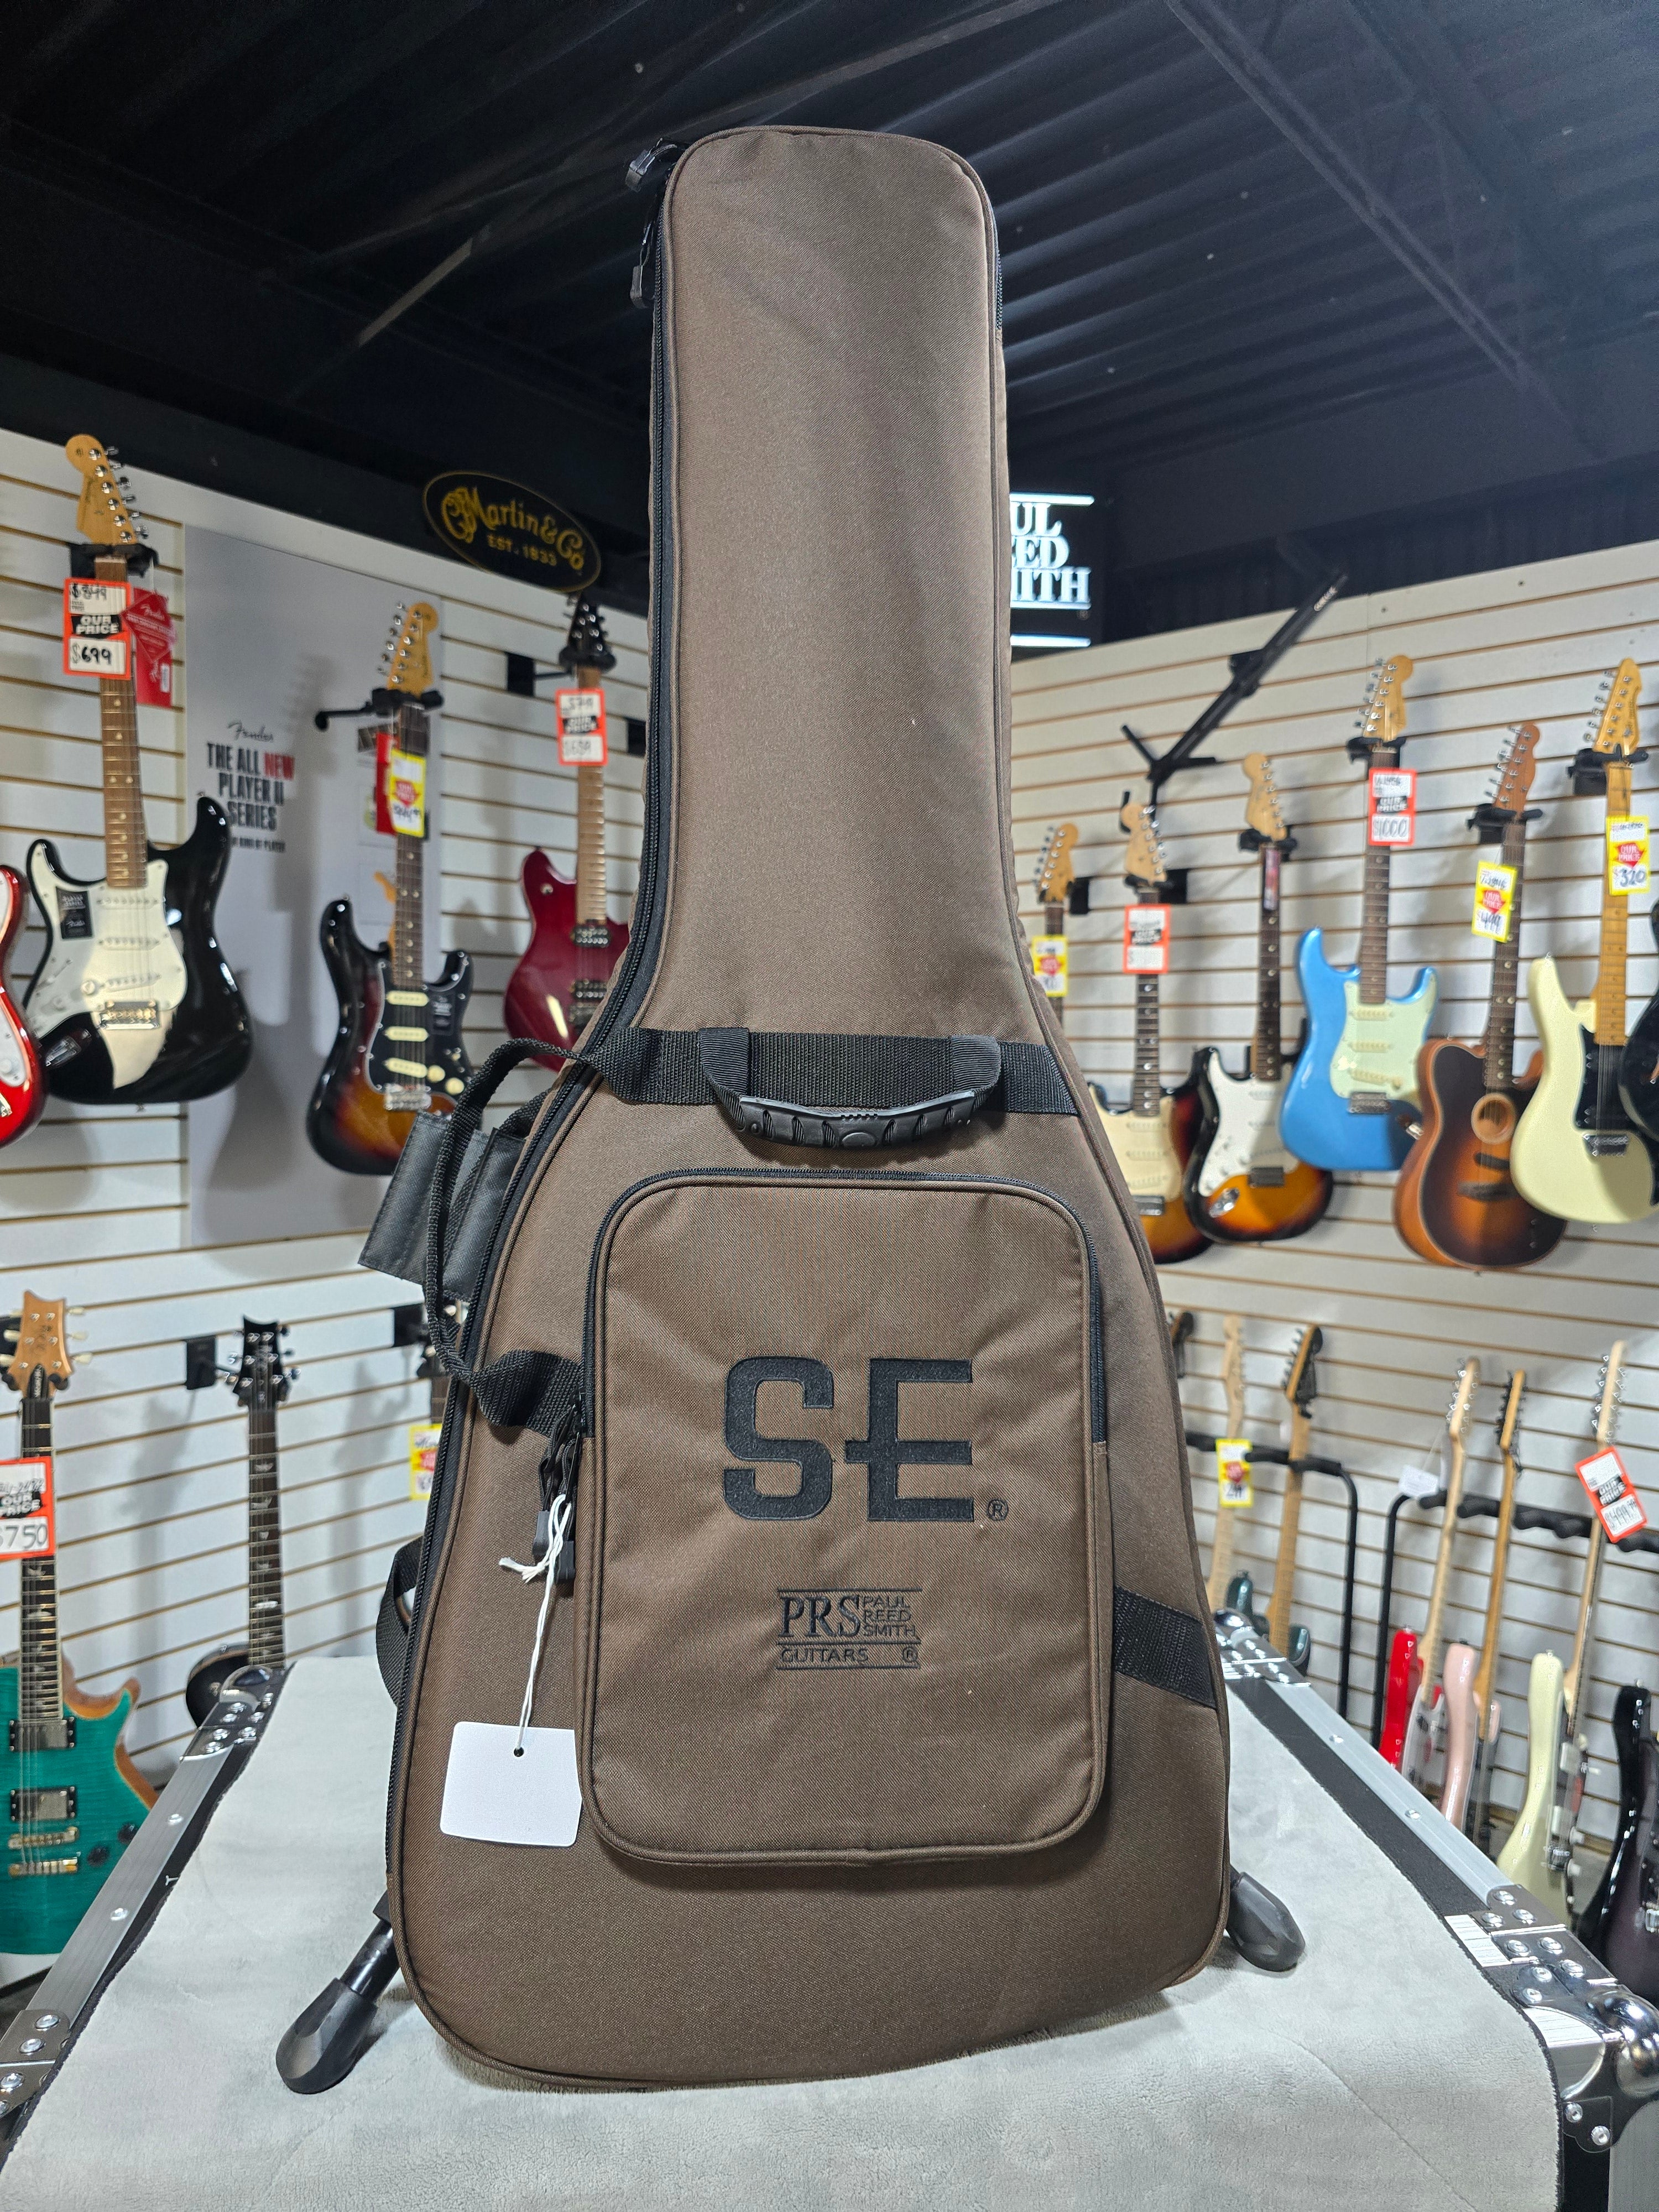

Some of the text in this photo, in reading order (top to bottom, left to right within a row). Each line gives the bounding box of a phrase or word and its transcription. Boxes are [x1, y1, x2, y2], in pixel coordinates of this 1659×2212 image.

[1010, 502, 1062, 536] UL
[1011, 536, 1070, 569] ED
[76, 624, 118, 635] PRICE
[80, 615, 112, 626] OUR
[226, 720, 274, 743] Fender
[207, 742, 295, 781] THE ALL NEW
[219, 773, 271, 803] PLAYER
[227, 801, 277, 832] SERIES
[2, 1494, 33, 1506] OUR
[862, 1595, 911, 1608] PAUL
[778, 1595, 861, 1637] PRS
[864, 1609, 912, 1622] REED
[863, 1624, 916, 1637] SMITH
[780, 1647, 869, 1662] GUITARS
